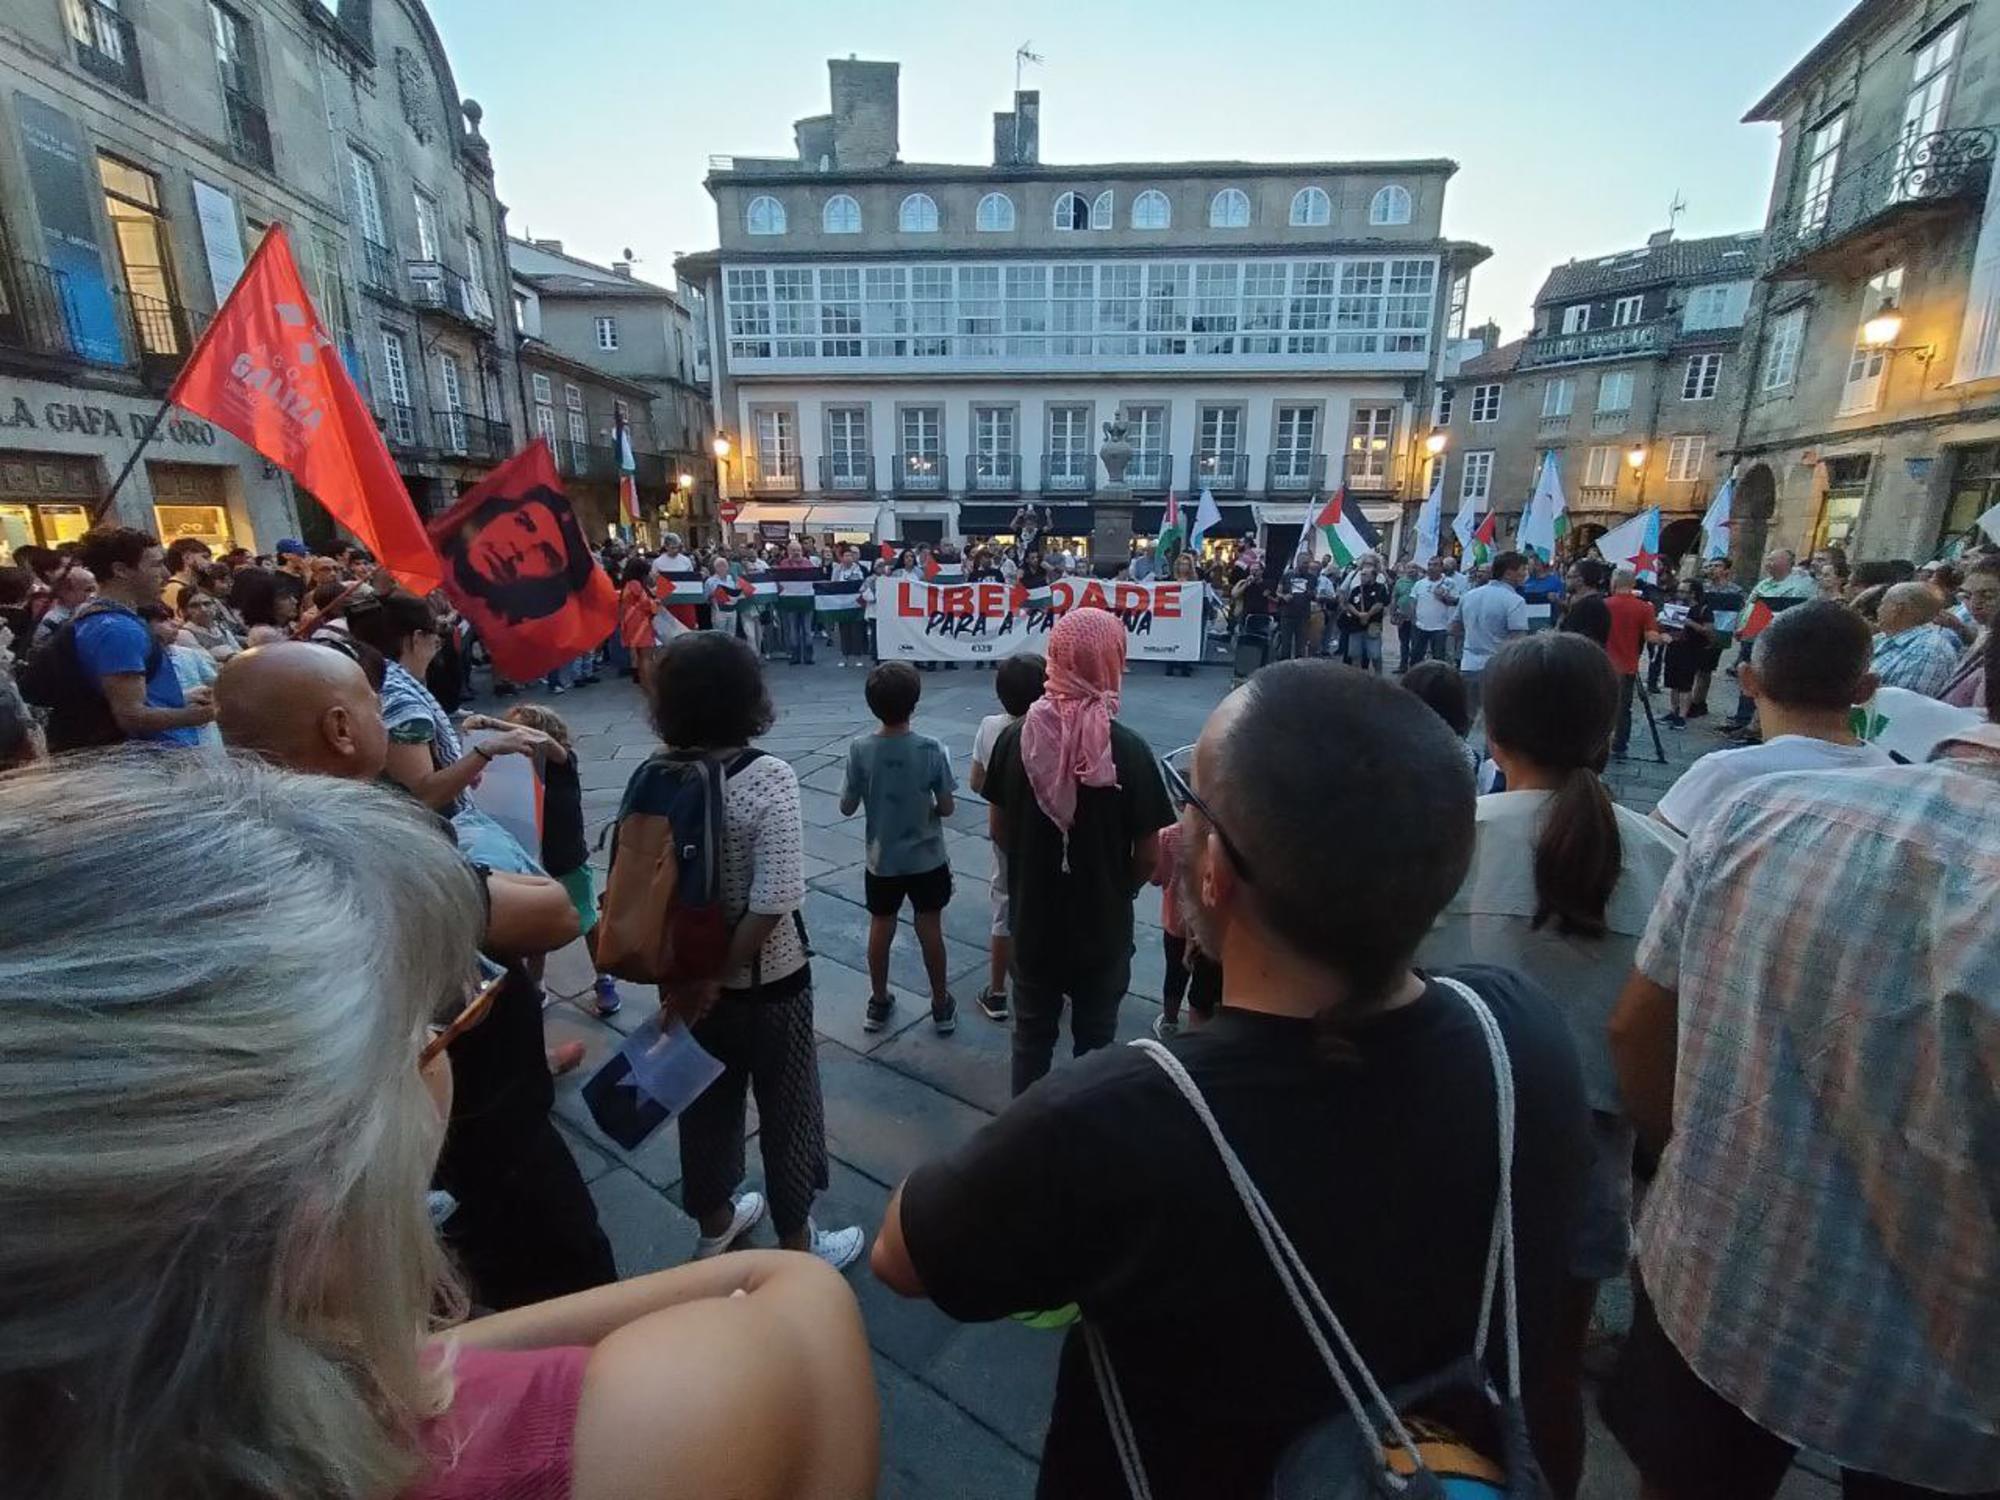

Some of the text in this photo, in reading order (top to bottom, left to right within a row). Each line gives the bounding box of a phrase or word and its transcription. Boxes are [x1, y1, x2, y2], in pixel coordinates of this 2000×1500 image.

[231, 352, 323, 431] GALIZA
[45, 402, 123, 438] GAFA
[169, 418, 216, 446] ORO
[925, 611, 986, 640] PARA
[998, 611, 1014, 636] A
